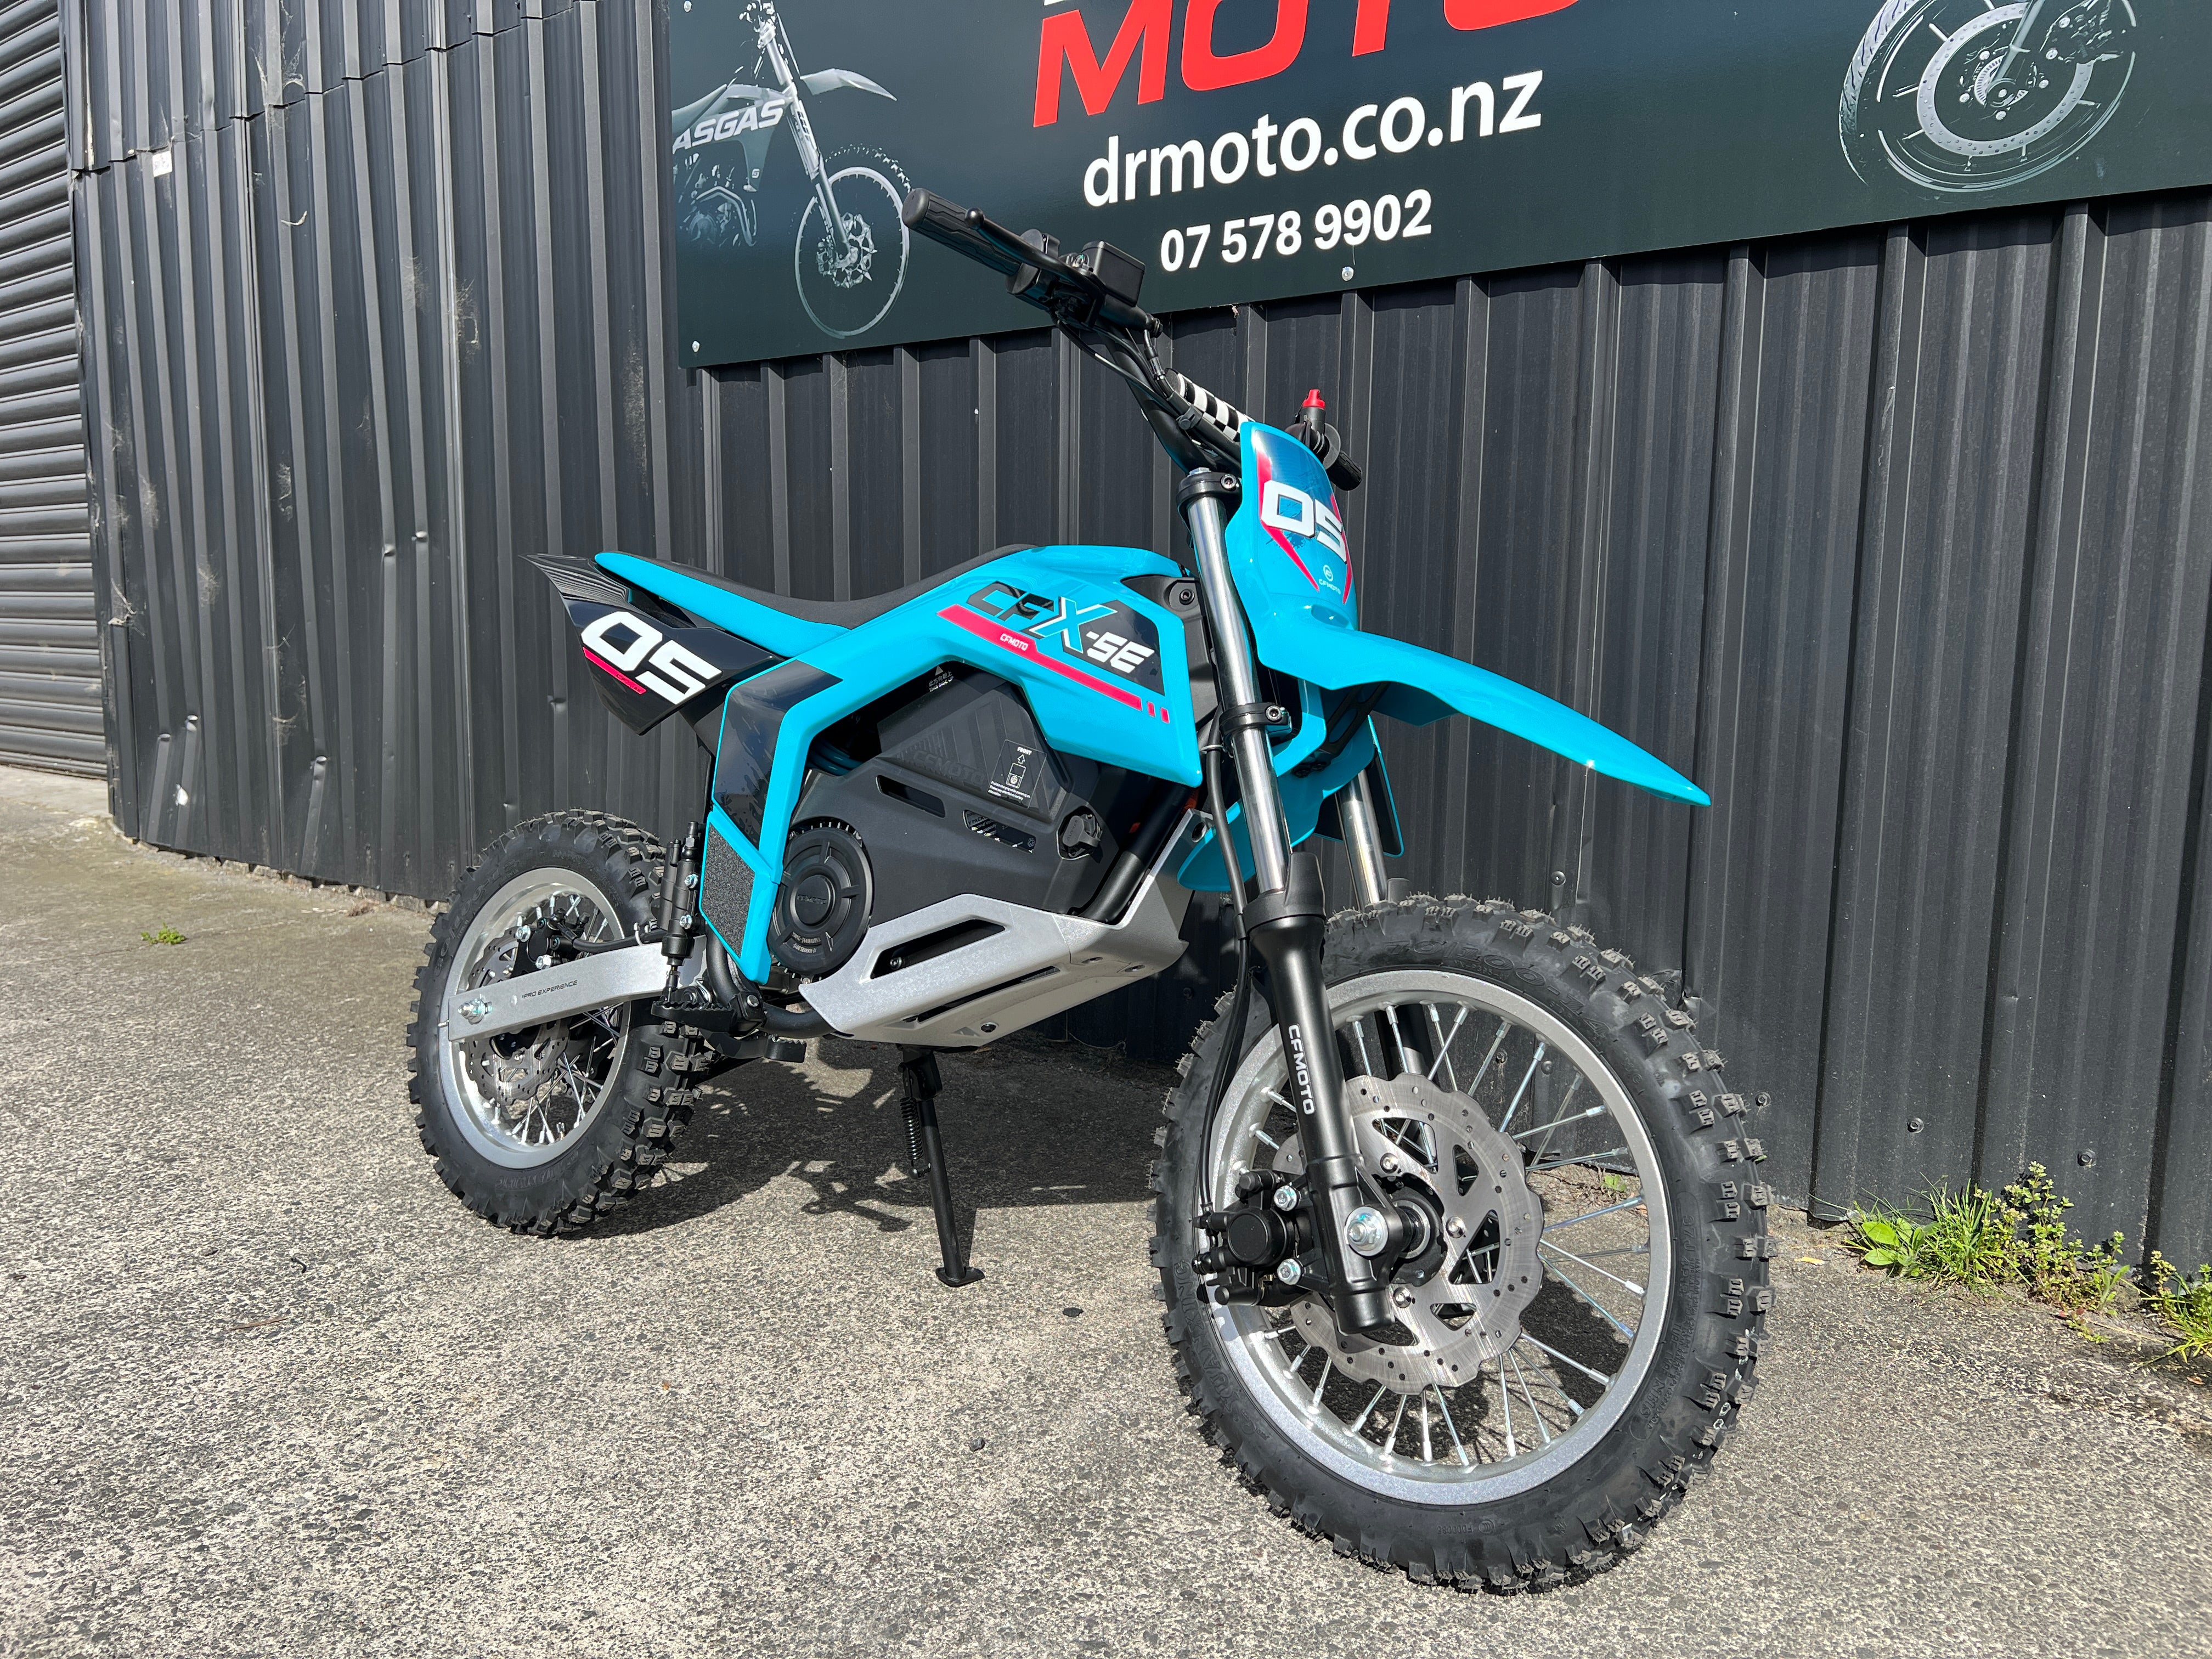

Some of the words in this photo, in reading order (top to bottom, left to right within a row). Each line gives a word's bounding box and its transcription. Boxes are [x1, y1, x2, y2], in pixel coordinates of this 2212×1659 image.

[1084, 70, 1543, 207] drmoto.co.nz
[1160, 225, 1211, 272] 07
[1222, 211, 1301, 263] 578
[1315, 189, 1432, 250] 9902
[1261, 479, 1348, 564] 05
[1318, 578, 1341, 595] CFMOTO
[580, 611, 723, 705] 05
[1000, 633, 1029, 652] CFMOTO
[1017, 746, 1032, 755] FRONT
[538, 979, 578, 995] EXPERIENCE
[1288, 1023, 1316, 1115] CFMOTO
[1681, 1215, 1696, 1252] 37J
